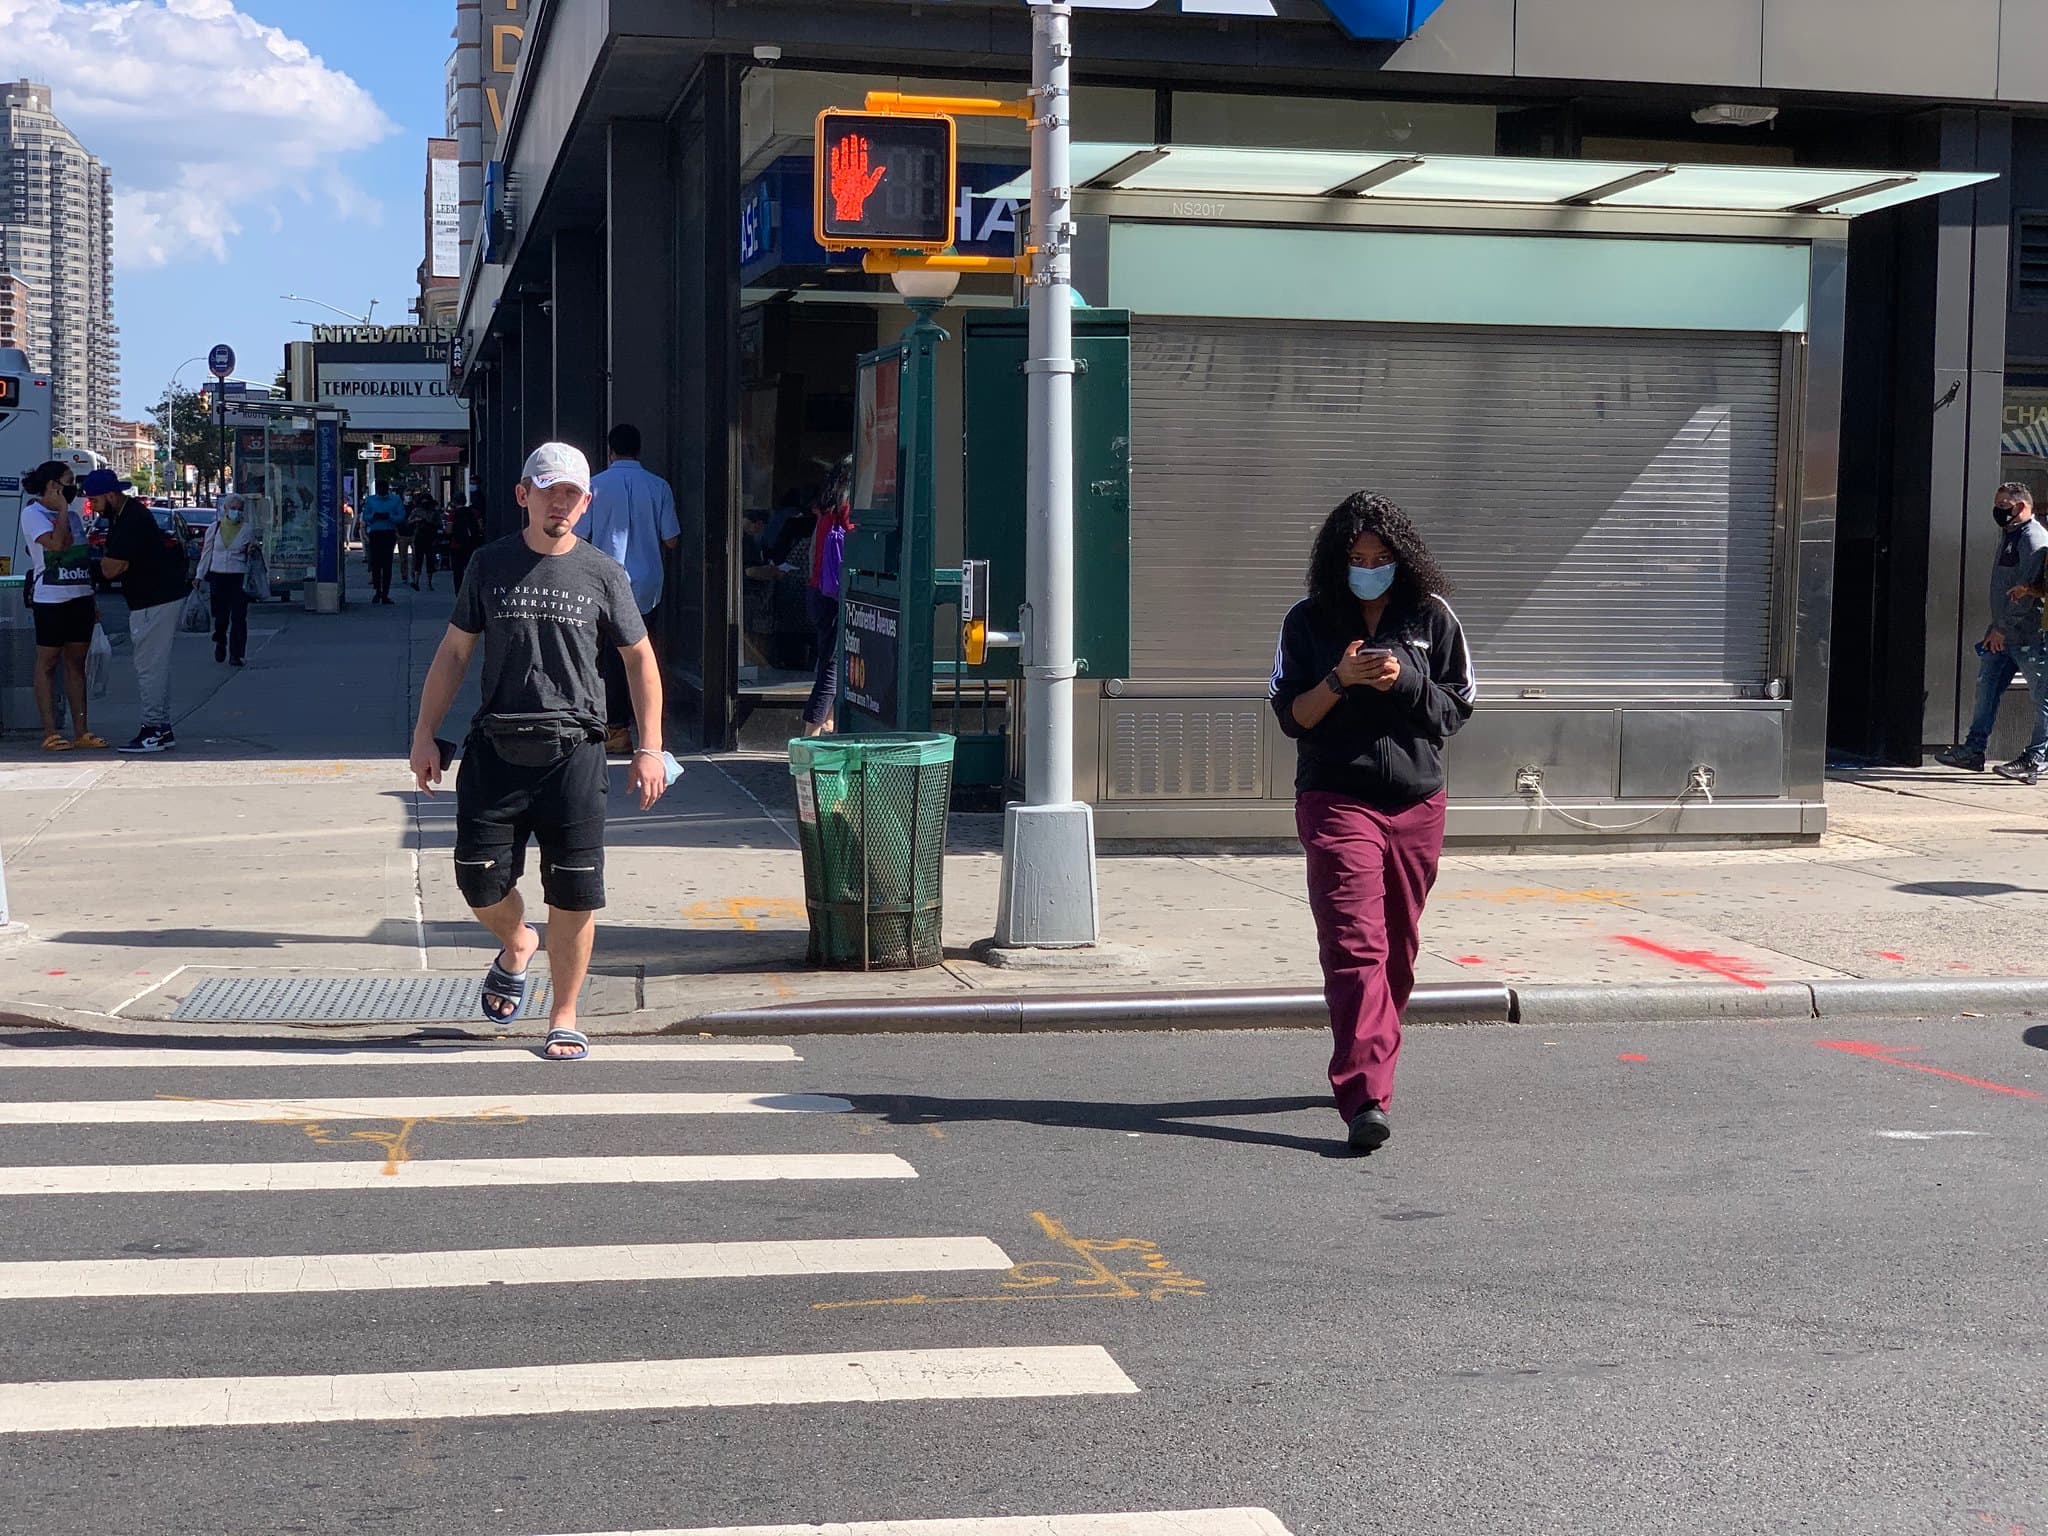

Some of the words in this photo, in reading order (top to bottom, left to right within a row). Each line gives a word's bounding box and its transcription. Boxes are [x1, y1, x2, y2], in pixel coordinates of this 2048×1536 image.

[1172, 202, 1226, 217] NS2017
[313, 325, 384, 343] UNITED
[453, 337, 462, 367] PARK
[323, 381, 423, 396] TEMPORARILY
[493, 587, 507, 595] IN
[514, 586, 569, 599] SEARCH
[577, 594, 593, 605] OF
[501, 599, 583, 615] NARRATIVE
[844, 628, 860, 655] Station
